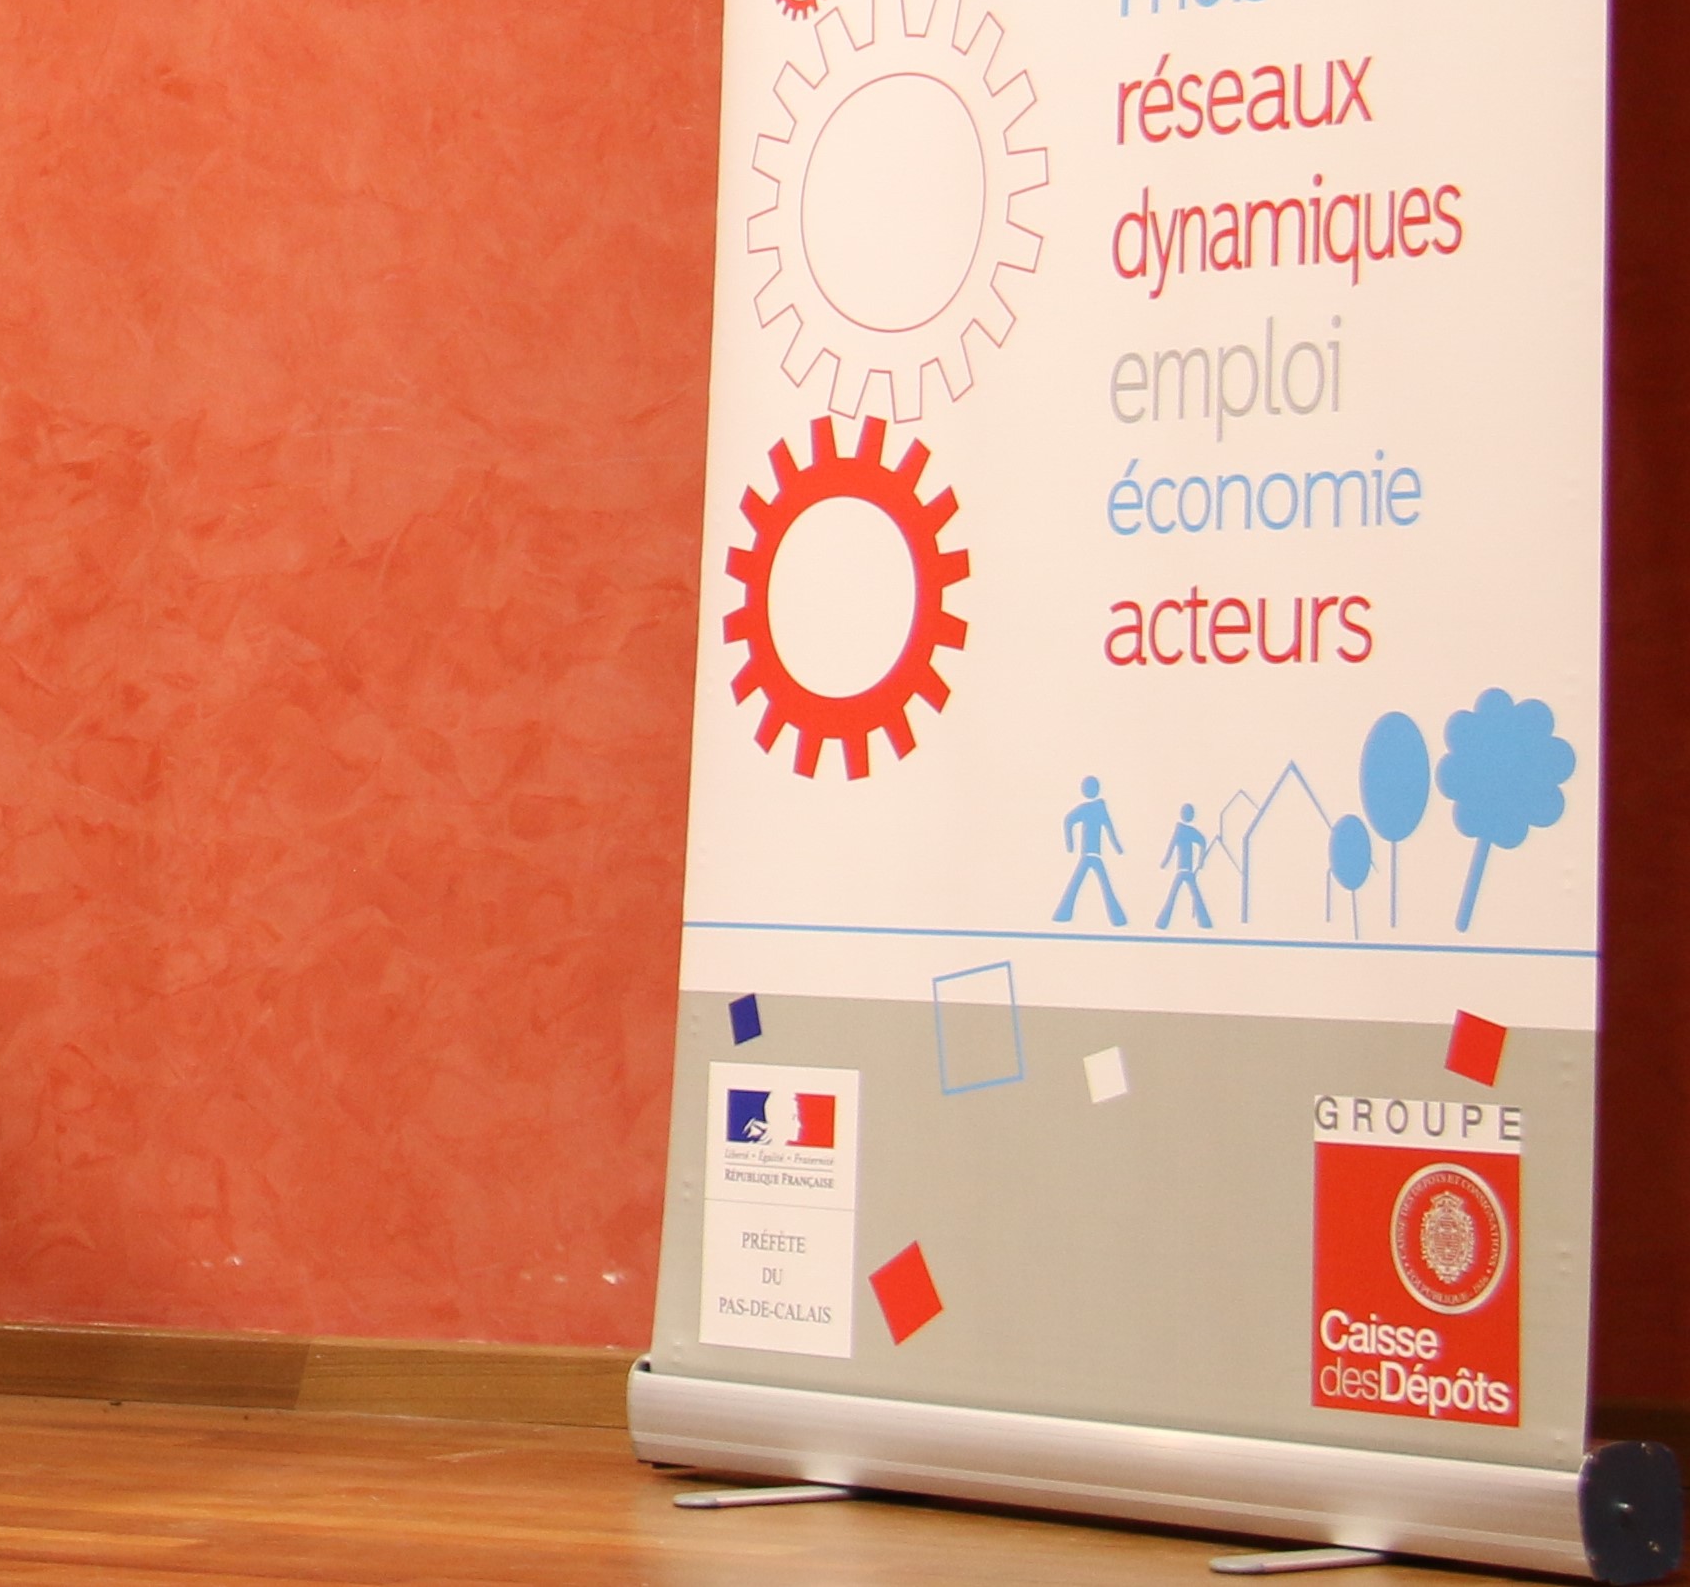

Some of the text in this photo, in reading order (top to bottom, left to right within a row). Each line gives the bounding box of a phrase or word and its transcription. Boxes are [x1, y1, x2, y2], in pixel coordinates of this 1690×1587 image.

[1115, 53, 1375, 147] réseaux
[1110, 172, 1464, 301] dynamiques
[1108, 314, 1344, 443] emploi
[1106, 448, 1422, 536] économie
[1103, 584, 1374, 667] acteurs
[1315, 1094, 1523, 1142] GROUPE
[781, 1172, 834, 1189] FRANÇAISE
[741, 1227, 807, 1255] PRÉFÈTE
[761, 1267, 784, 1286] DU
[718, 1296, 833, 1325] PAS-DE-CALAIS
[1320, 1309, 1439, 1360] Caisse
